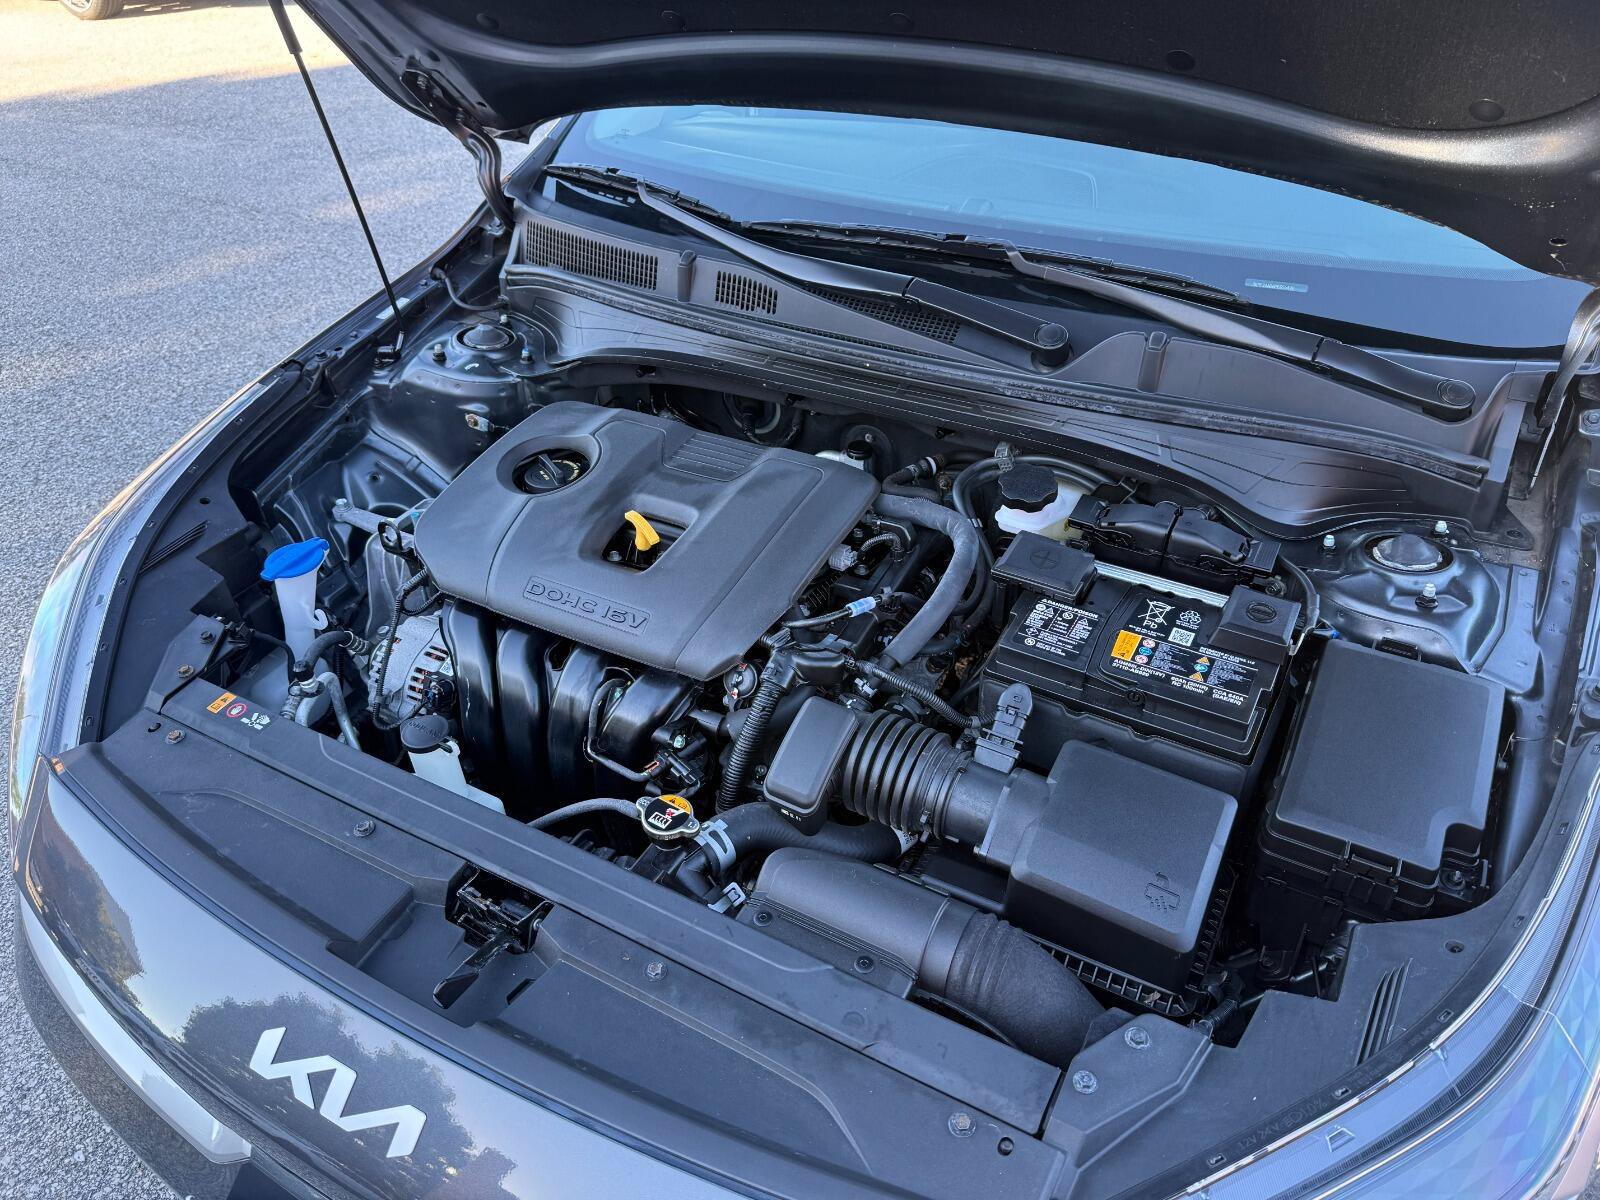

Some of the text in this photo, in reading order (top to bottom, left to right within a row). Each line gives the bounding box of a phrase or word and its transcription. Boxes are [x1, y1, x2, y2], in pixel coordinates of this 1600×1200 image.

[526, 582, 648, 629] DOHC 16V
[1048, 600, 1099, 619] DANGER/POISON
[1143, 620, 1158, 629] Pb
[249, 1026, 427, 1158] KIA
